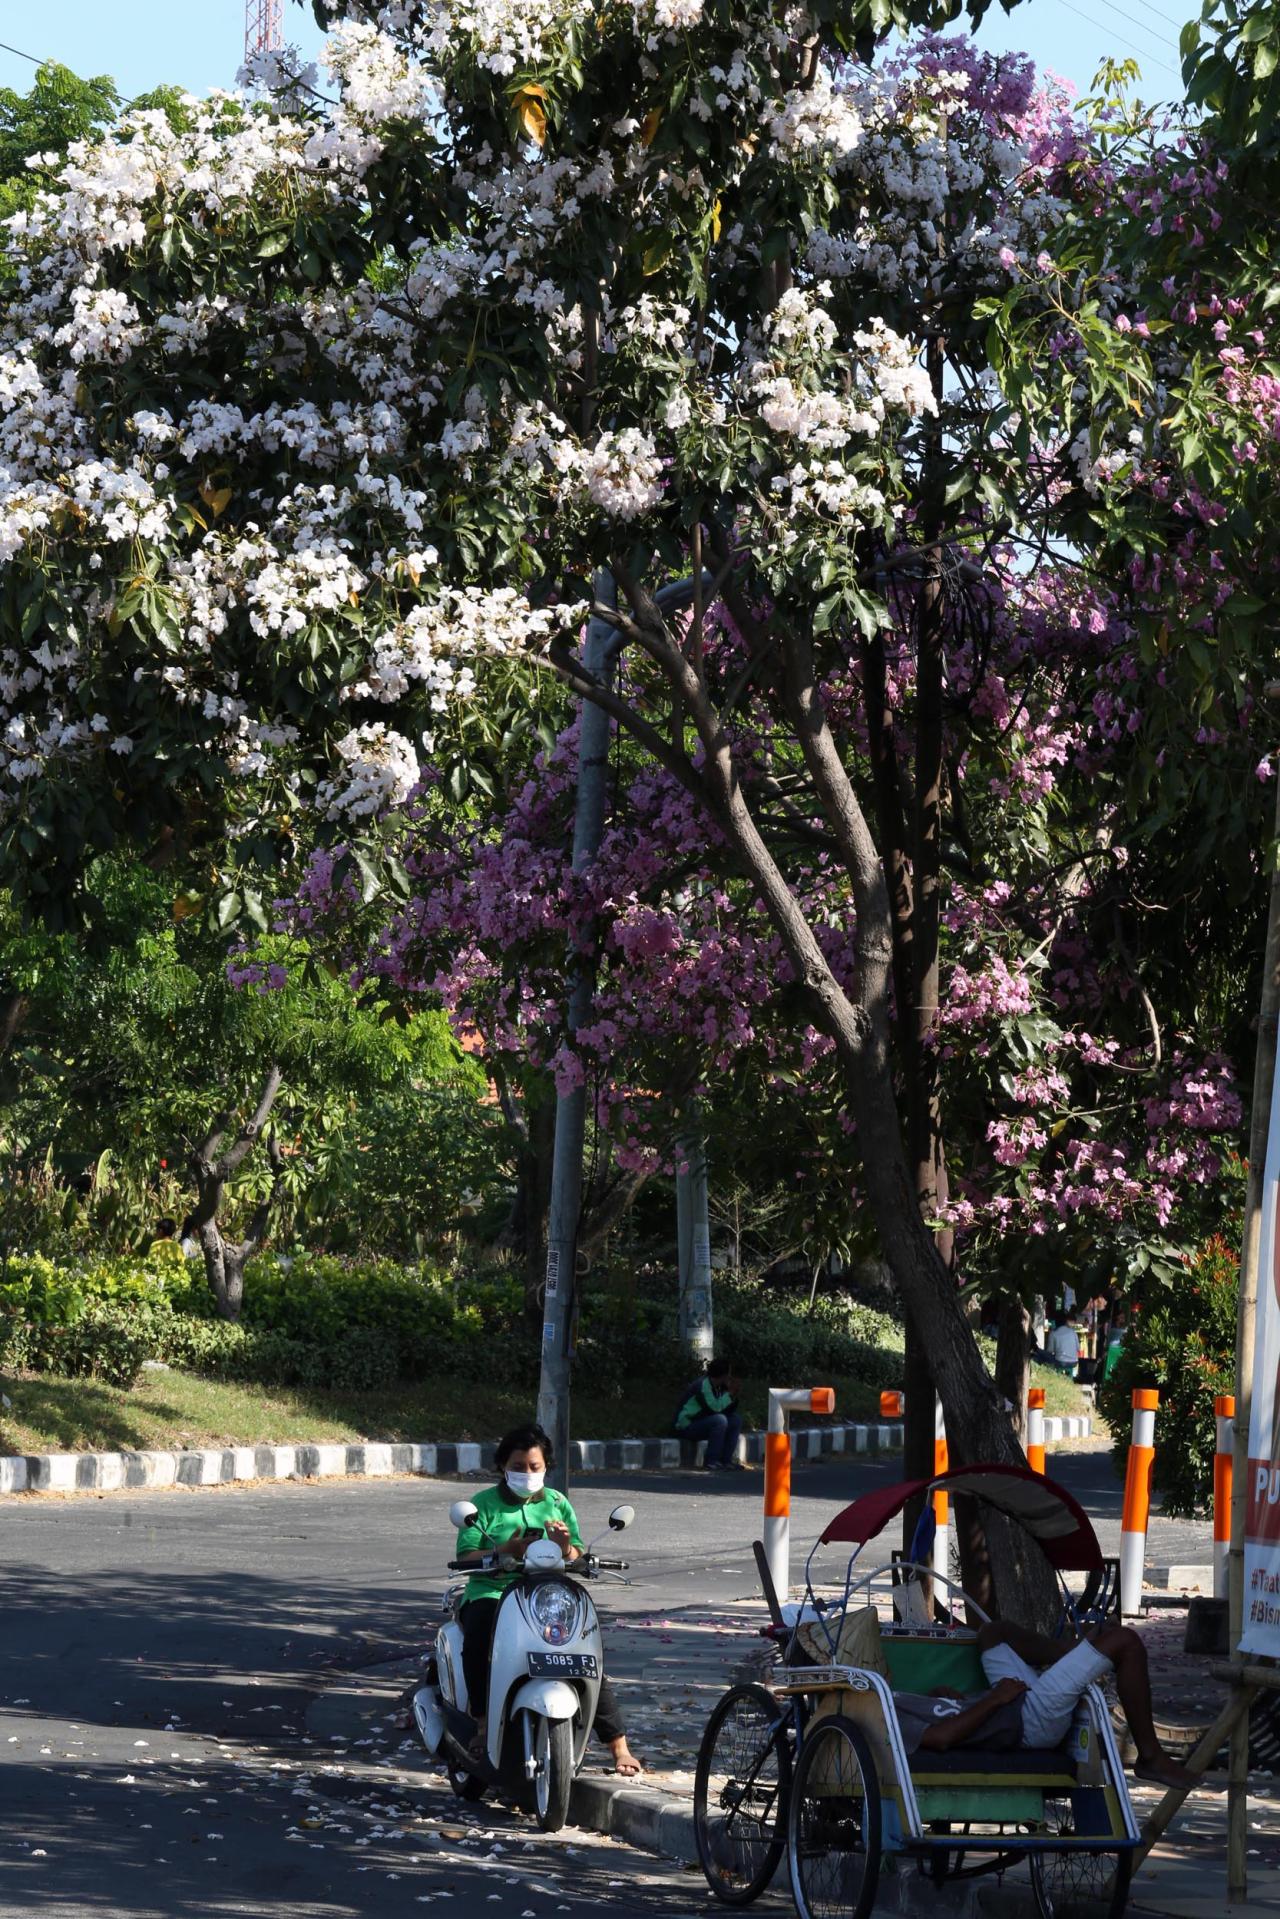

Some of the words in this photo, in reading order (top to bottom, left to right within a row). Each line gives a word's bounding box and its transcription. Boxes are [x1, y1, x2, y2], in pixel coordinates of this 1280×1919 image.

[530, 1653, 537, 1664] L
[545, 1655, 574, 1665] 5085
[581, 1656, 596, 1667] FJ
